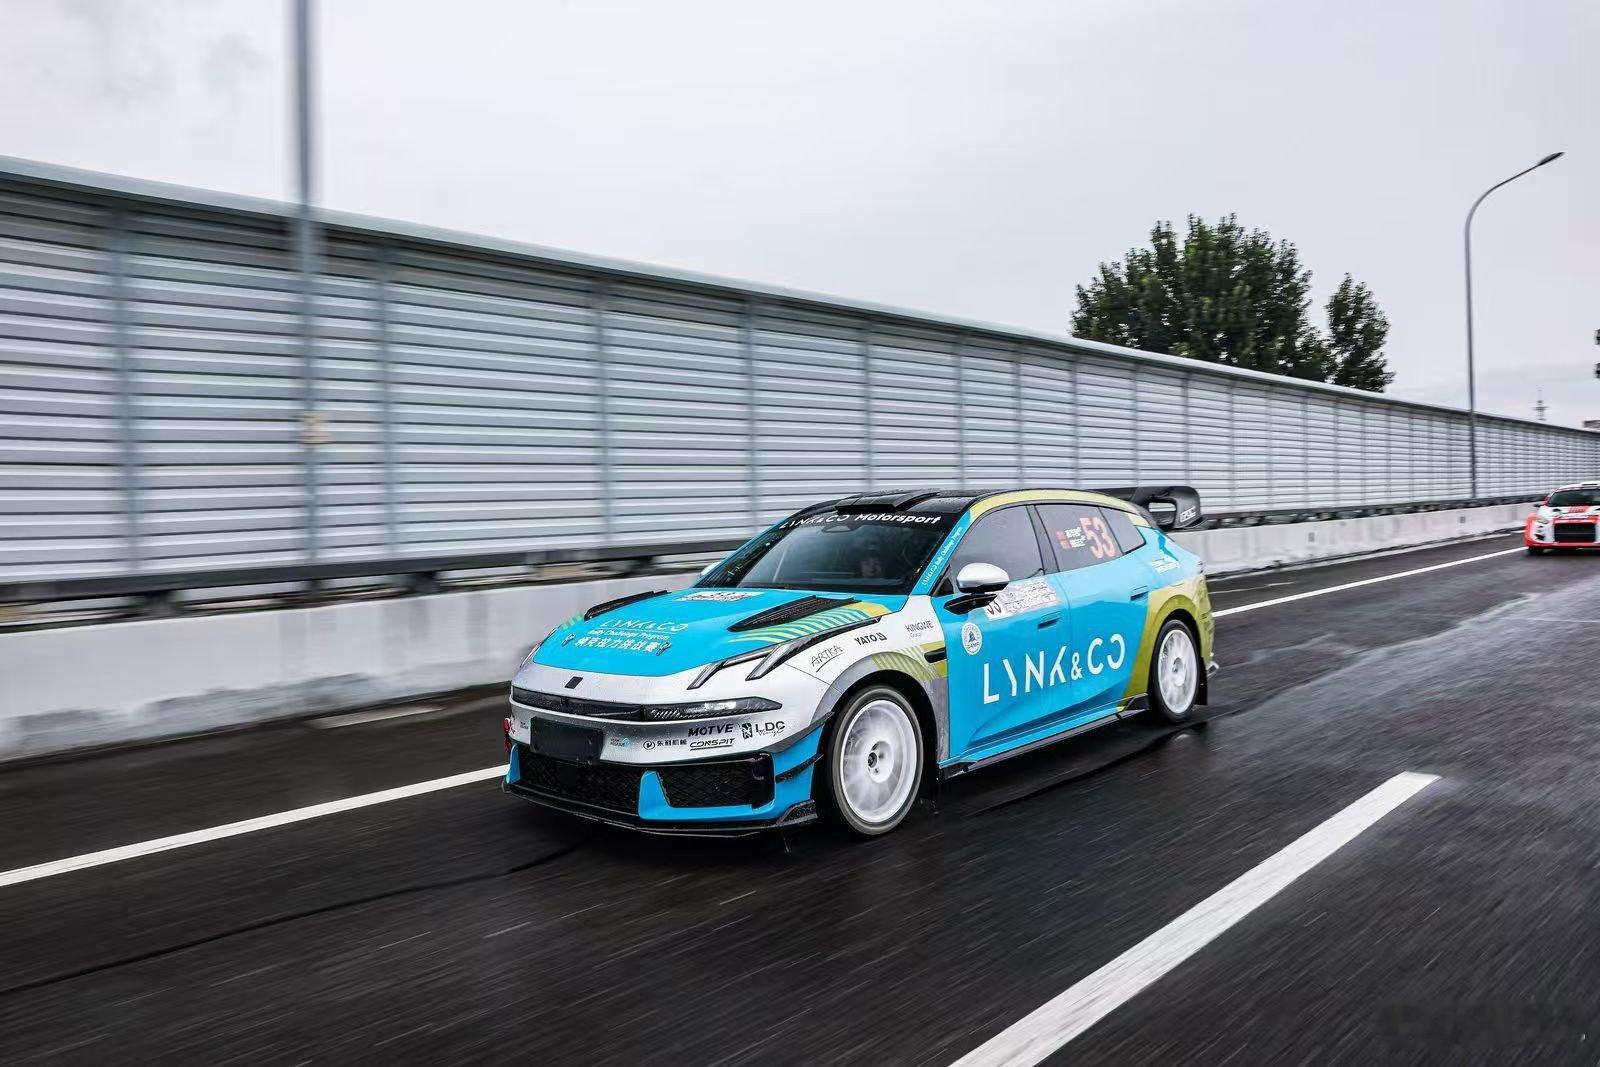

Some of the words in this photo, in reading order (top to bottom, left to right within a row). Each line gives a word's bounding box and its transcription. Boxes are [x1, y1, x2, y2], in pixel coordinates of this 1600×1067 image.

[854, 513, 942, 525] Motorsport
[1080, 516, 1116, 558] 53
[600, 618, 688, 632] LYNK&CO
[854, 634, 878, 646] YATO
[984, 633, 1126, 705] LYNK&CO
[688, 723, 734, 737] MOTVE
[755, 721, 786, 733] LDC
[690, 738, 735, 748] CONSPIT
